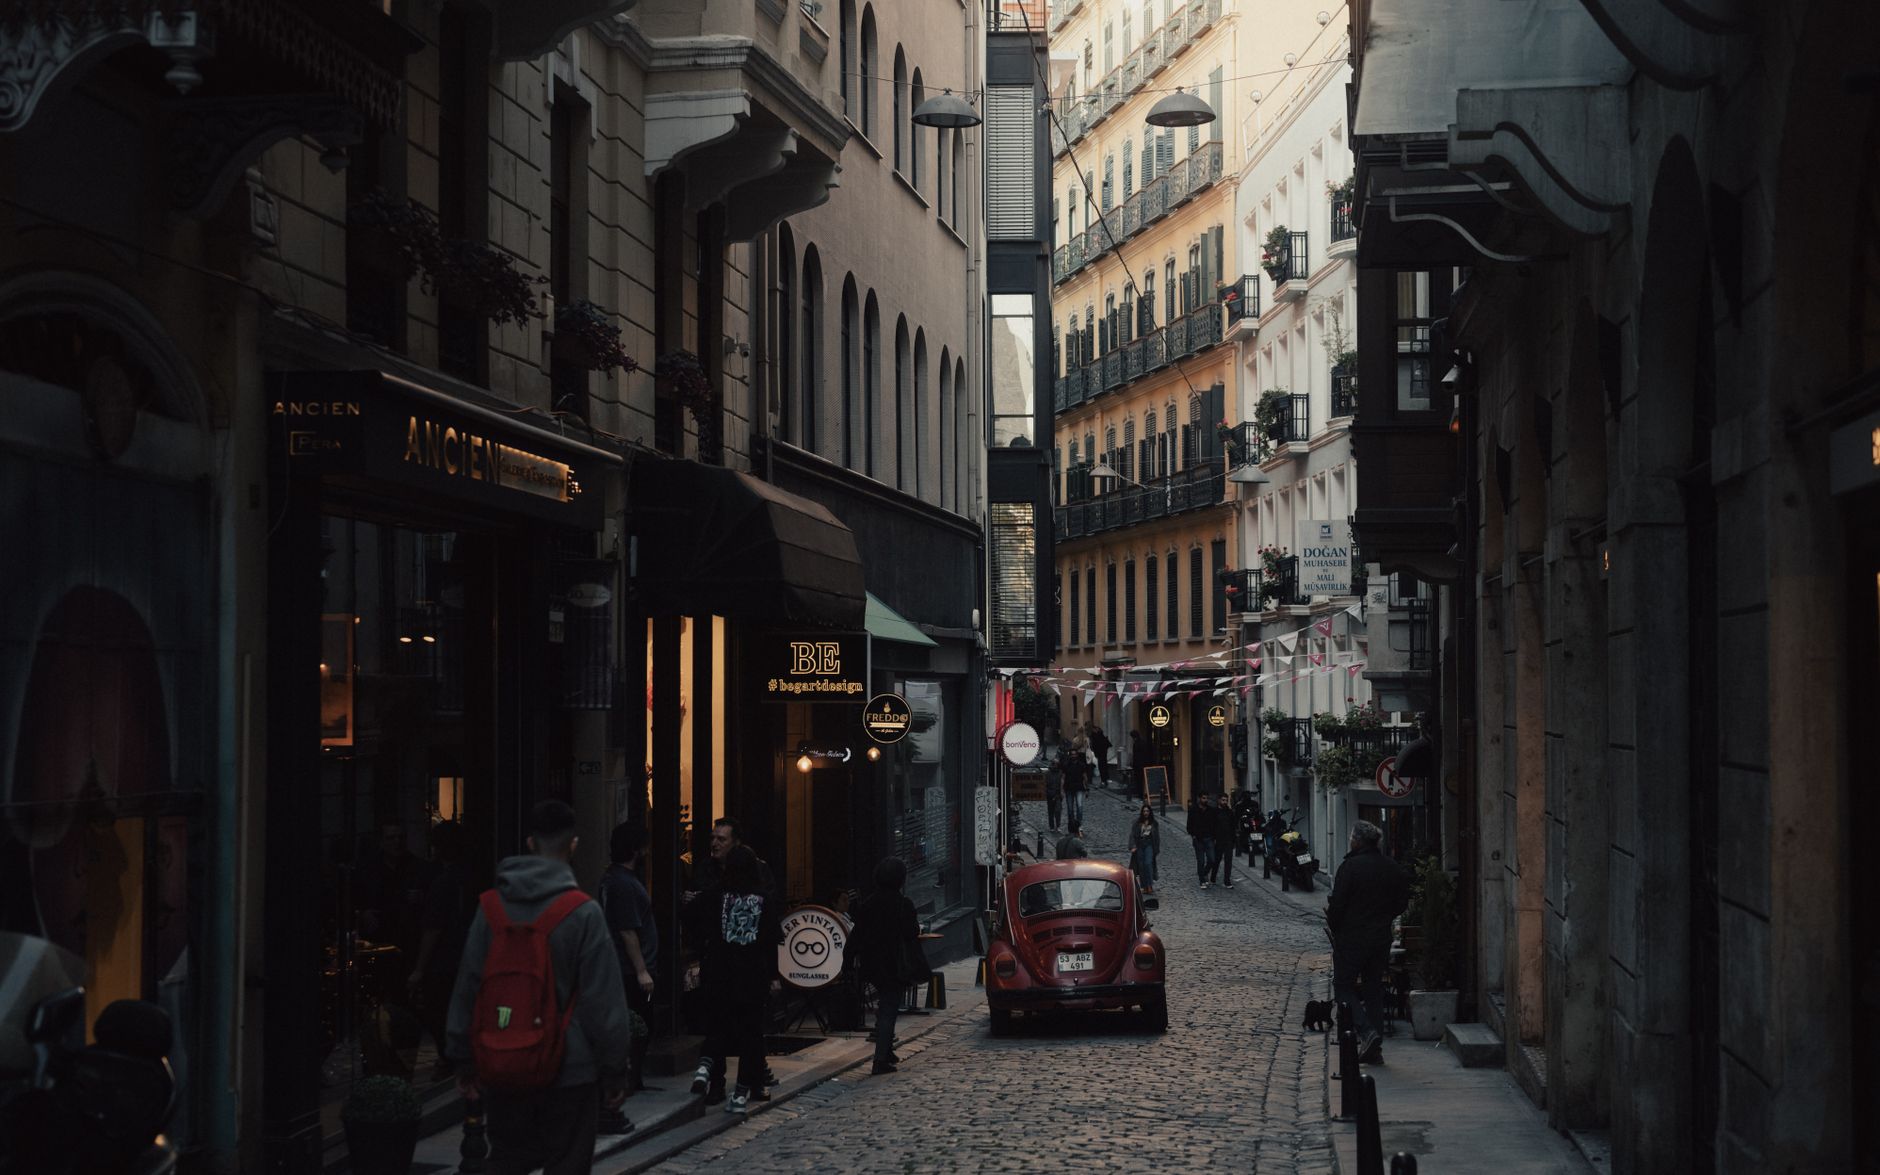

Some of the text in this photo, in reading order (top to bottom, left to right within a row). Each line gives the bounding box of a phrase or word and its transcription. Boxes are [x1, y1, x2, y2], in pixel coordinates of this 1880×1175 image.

[272, 401, 361, 416] ANCIEN
[1303, 545, 1347, 558] DOĞAN
[790, 642, 840, 675] BE
[802, 915, 843, 949] VINTAGE
